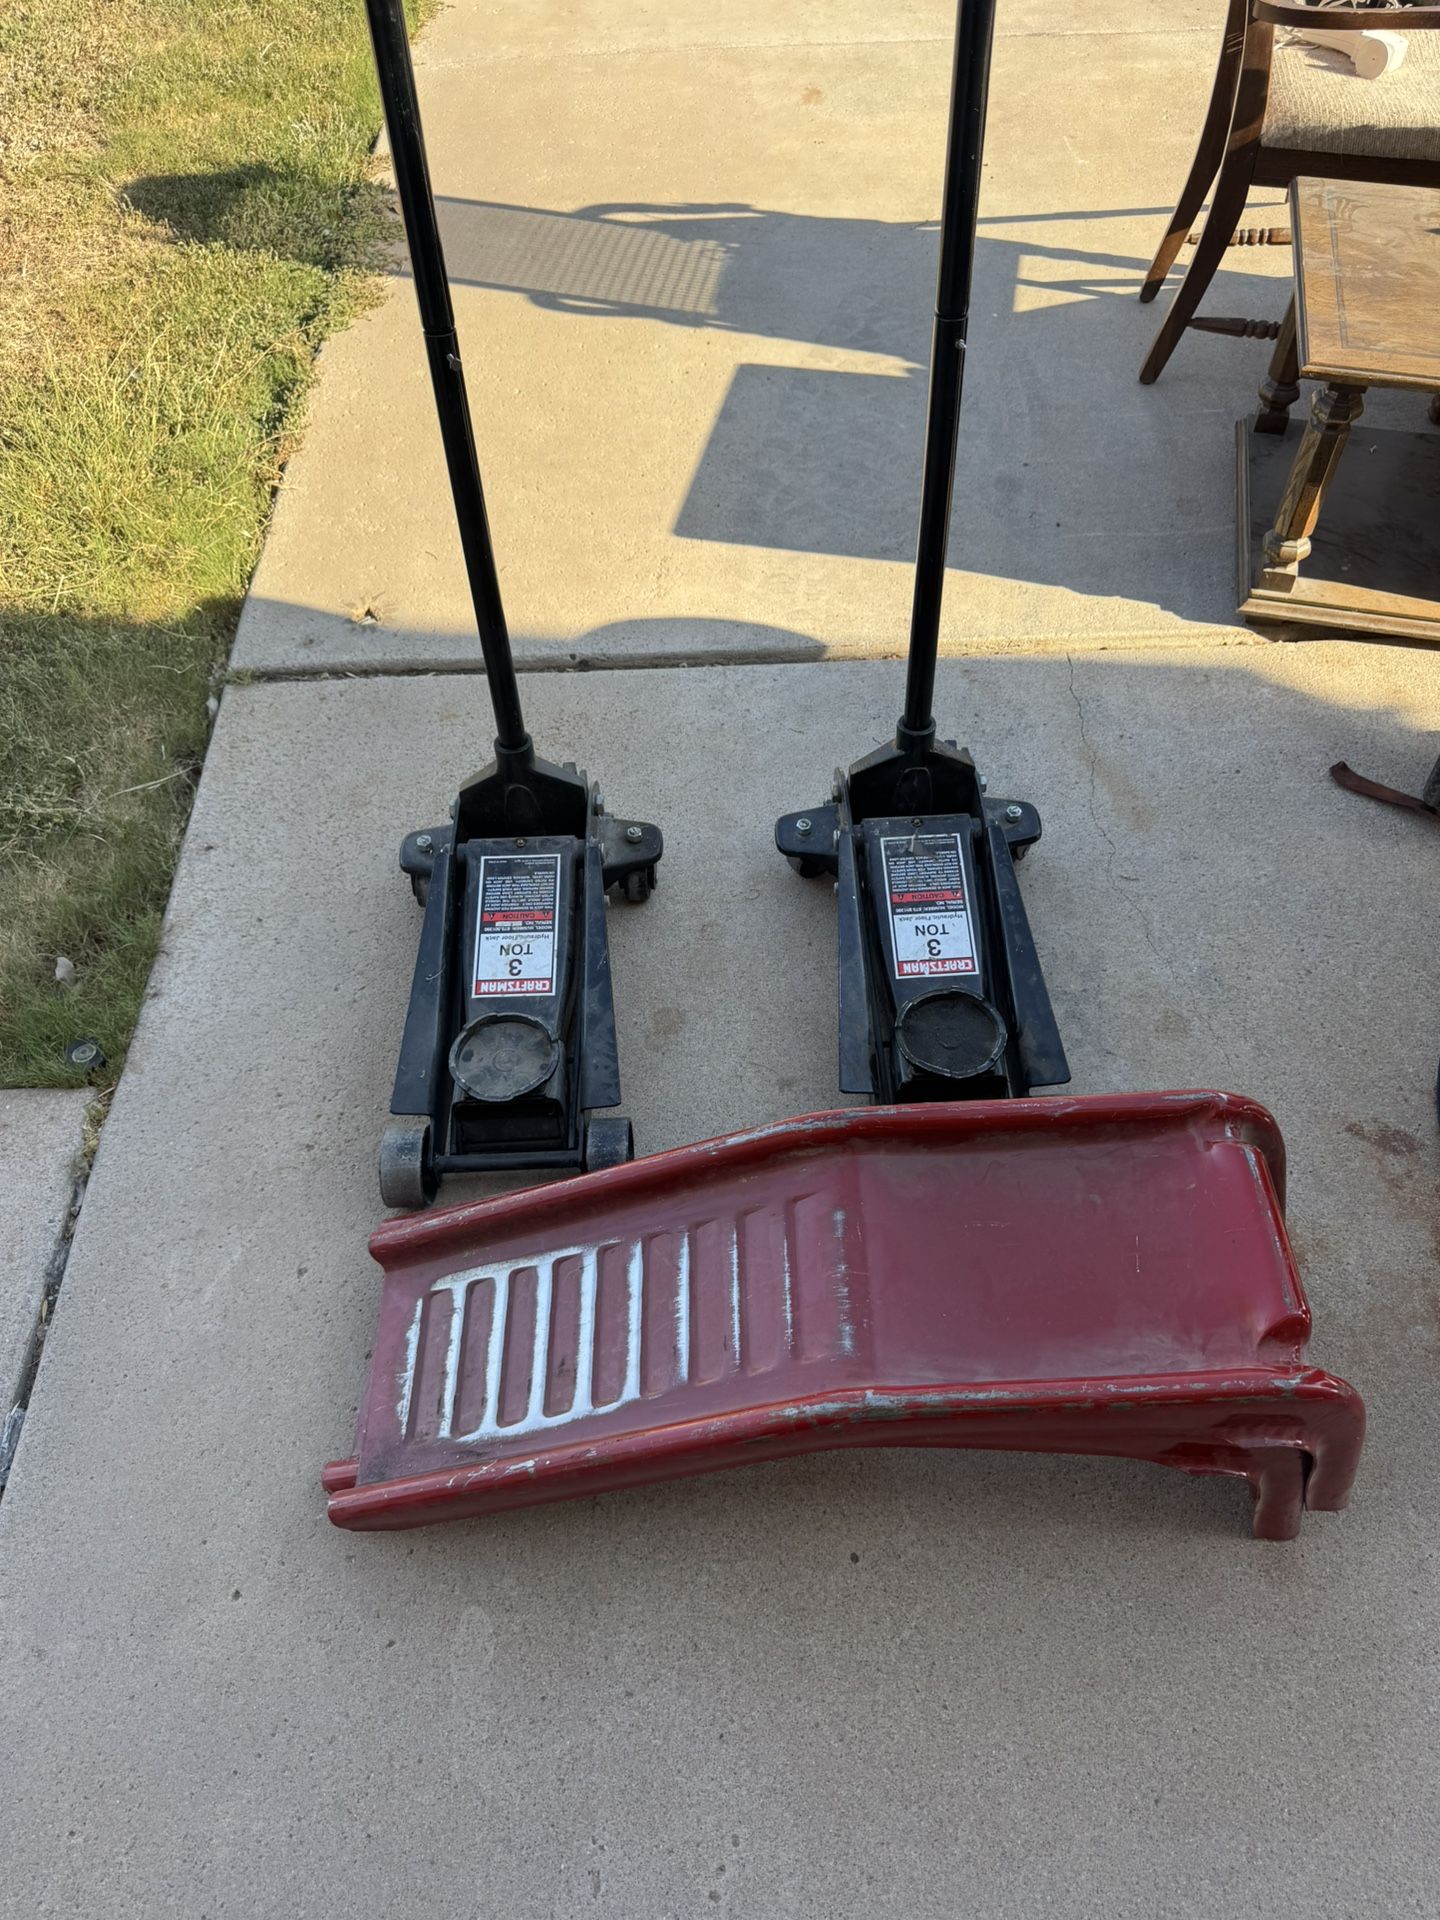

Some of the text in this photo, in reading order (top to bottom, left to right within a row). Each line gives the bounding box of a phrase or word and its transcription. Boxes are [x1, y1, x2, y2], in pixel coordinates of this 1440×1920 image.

[932, 912, 963, 920] Hydraulic
[915, 923, 949, 936] TON
[500, 944, 533, 956] TON
[927, 939, 942, 956] 3
[508, 959, 522, 976] 3
[902, 959, 973, 973] CRAFTSMAN
[480, 980, 550, 993] CRAFTSMAN
